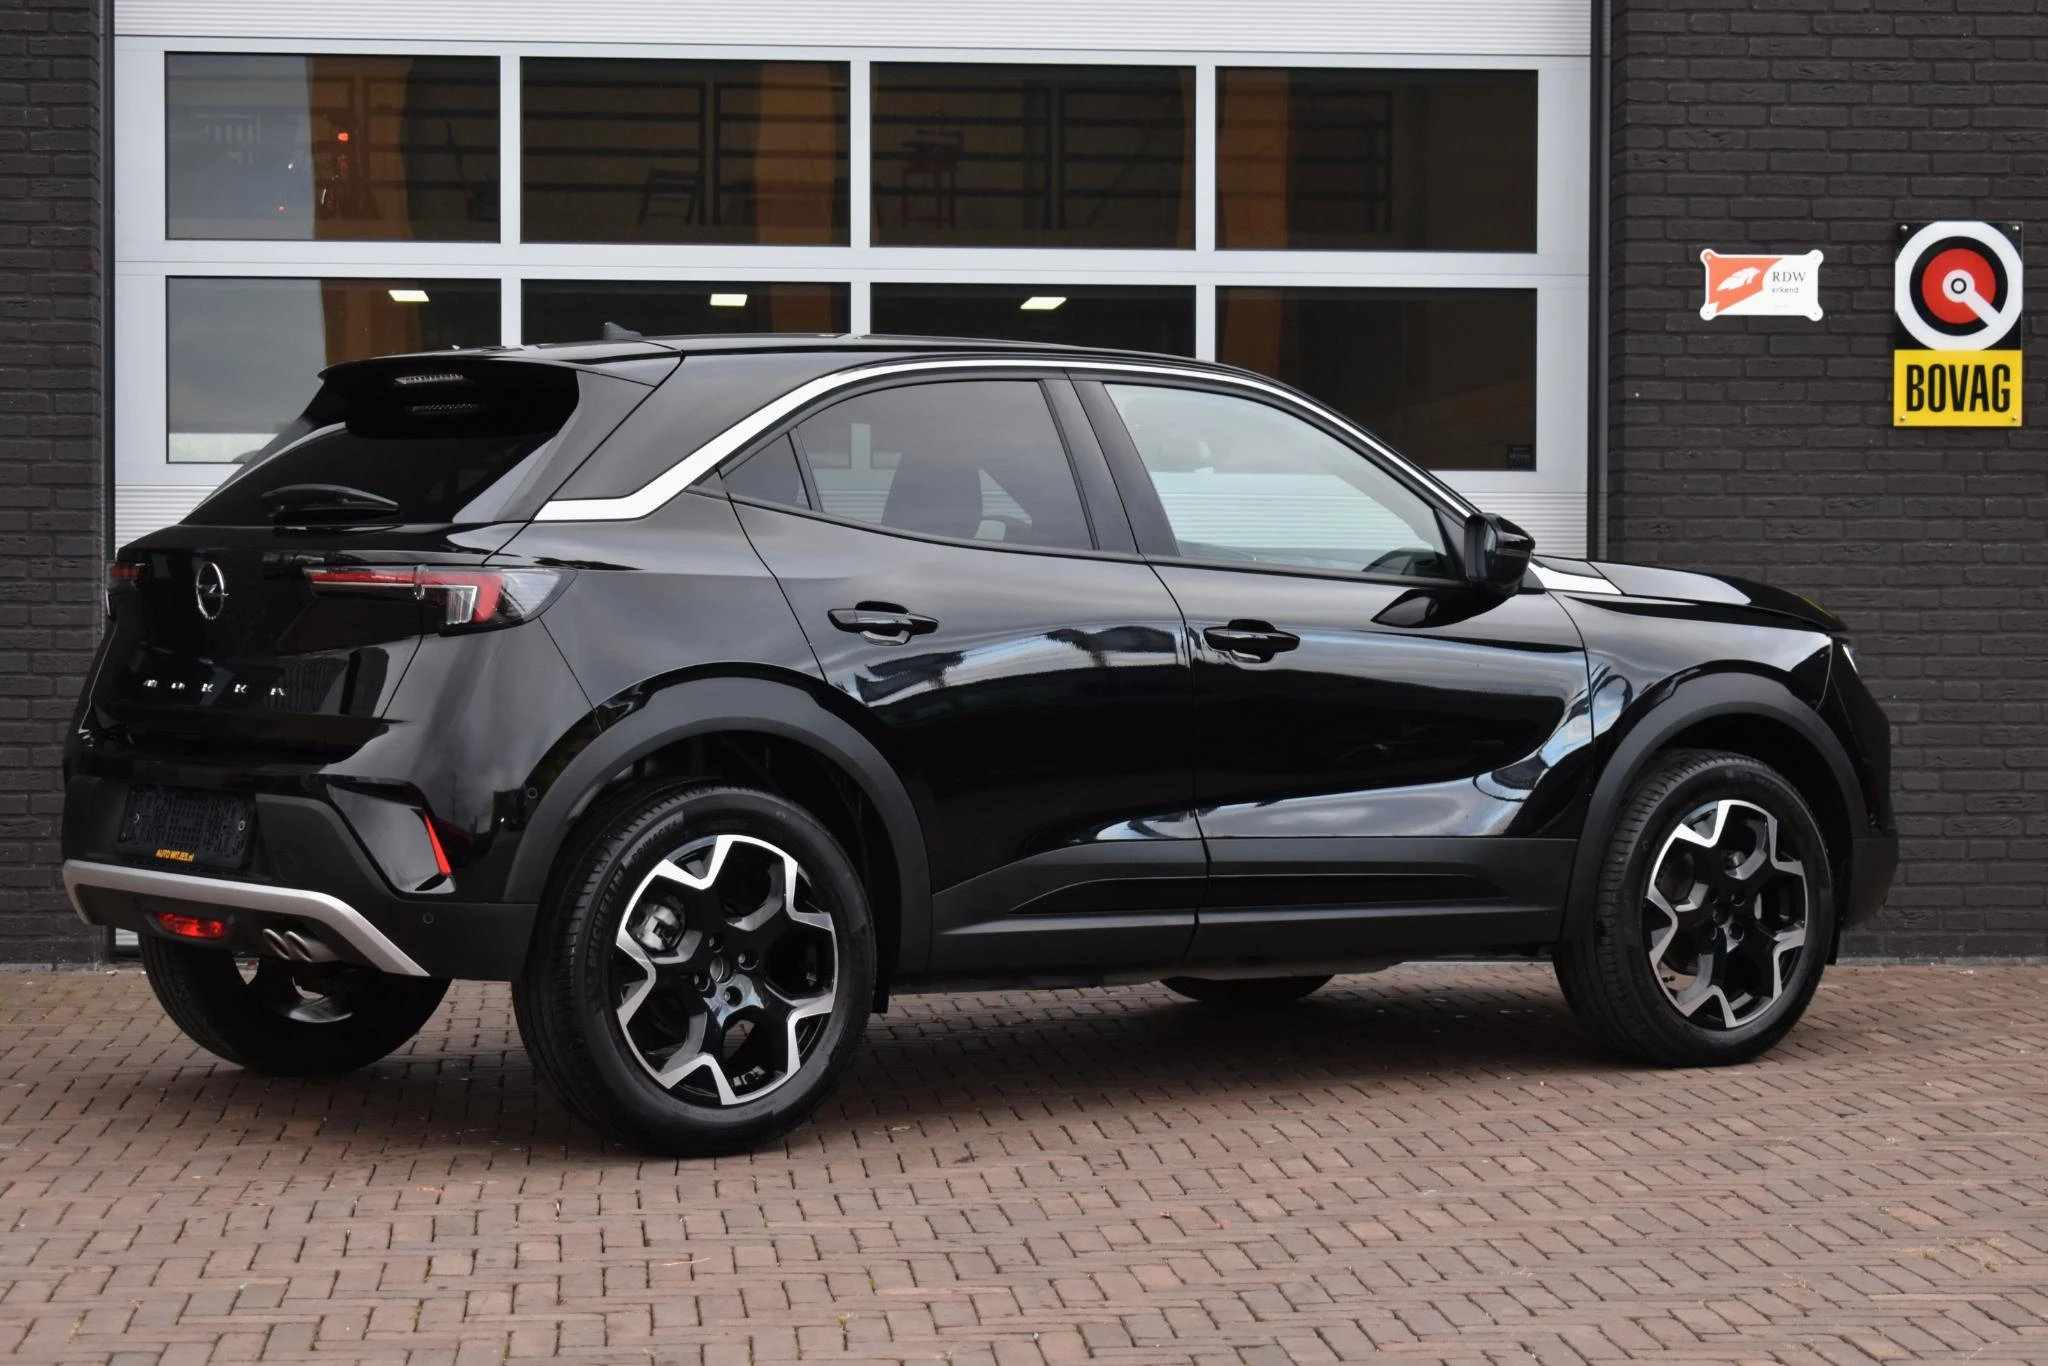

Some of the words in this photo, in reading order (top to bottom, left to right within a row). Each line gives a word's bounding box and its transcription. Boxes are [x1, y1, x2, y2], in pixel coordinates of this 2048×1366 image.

[1772, 271, 1807, 282] RDW
[1771, 286, 1799, 295] erkend
[1906, 363, 2011, 413] BOVAG
